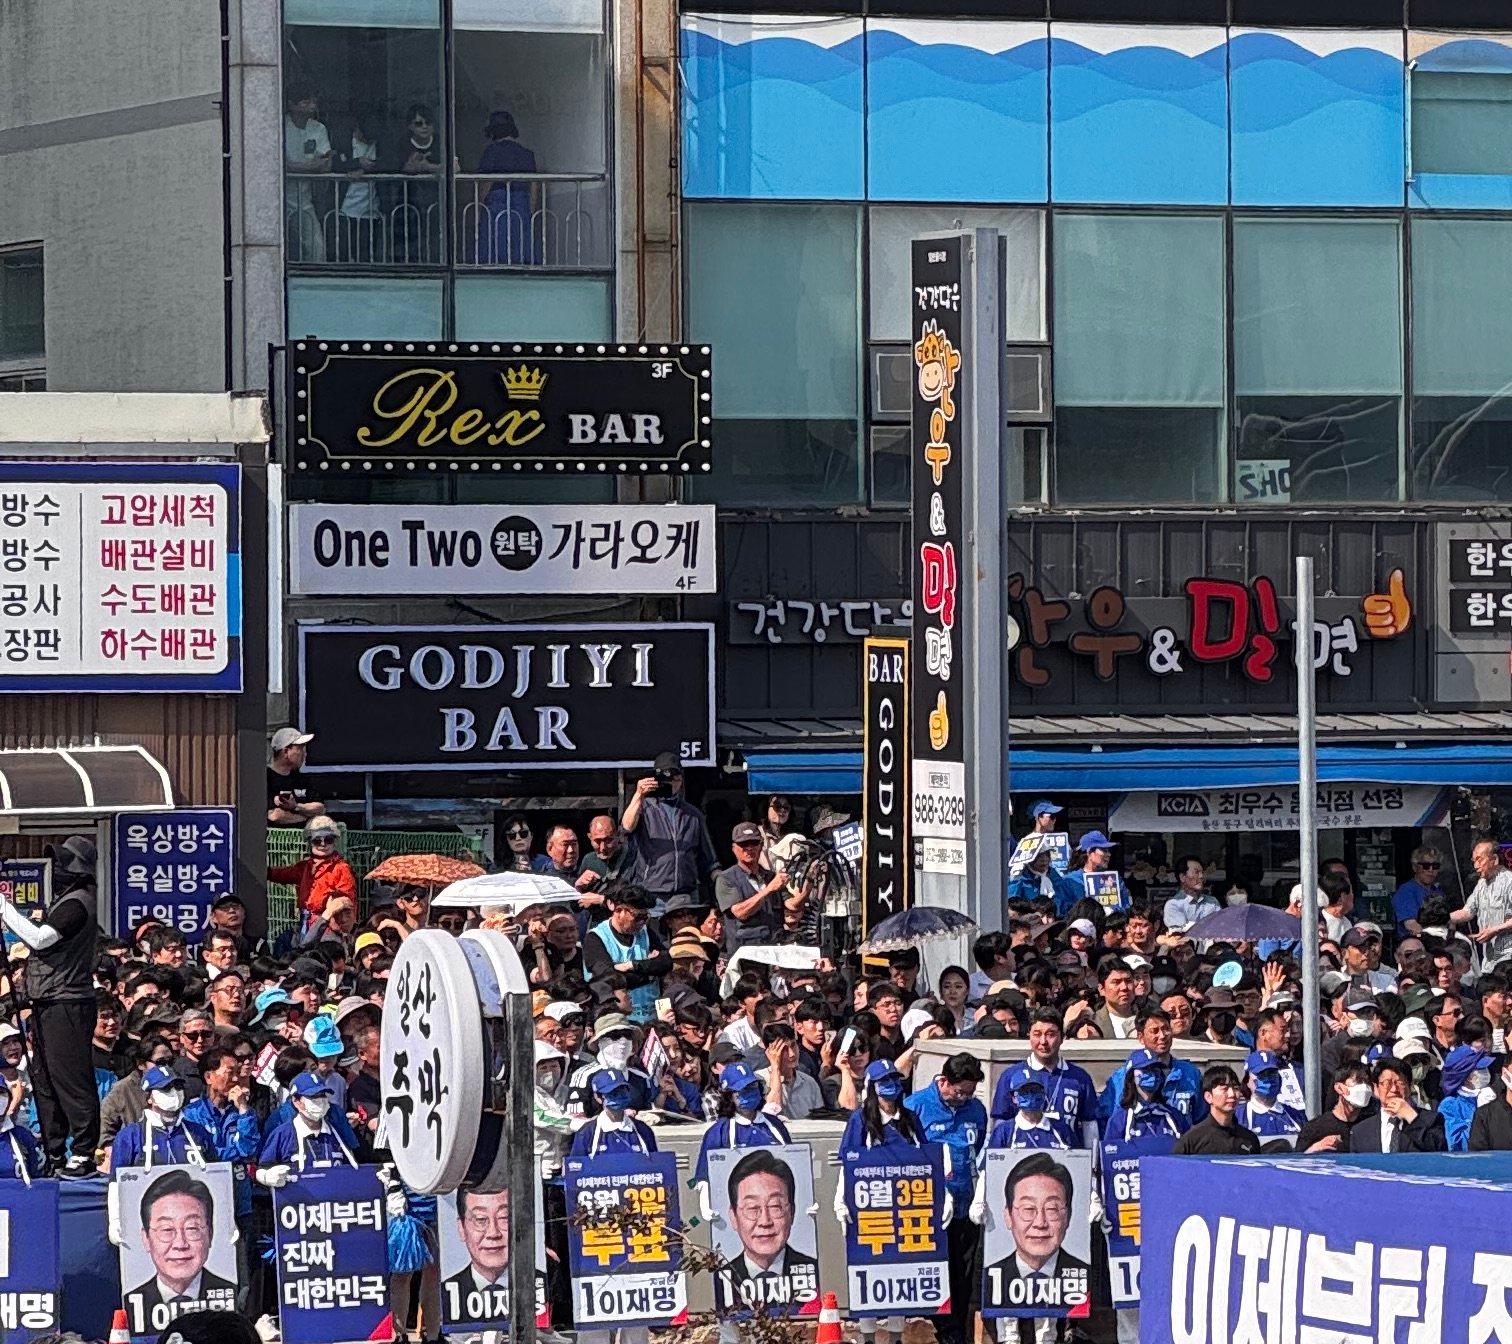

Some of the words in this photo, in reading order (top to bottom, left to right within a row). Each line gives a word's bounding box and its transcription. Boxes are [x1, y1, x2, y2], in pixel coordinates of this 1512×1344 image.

[651, 362, 673, 379] 3F
[357, 367, 546, 448] Rex
[569, 413, 665, 445] BAR
[2, 494, 61, 527] 방수
[100, 494, 215, 527] 고압세척
[2, 539, 61, 573] 방수
[100, 539, 215, 572] 배관설비
[313, 519, 390, 567] One
[401, 520, 482, 567] Two
[494, 530, 539, 556] 원탁
[548, 519, 700, 570] 가라오케
[675, 575, 698, 591] 4F
[1, 584, 62, 617] 공사
[100, 584, 217, 616] 수도배관
[100, 629, 217, 661] 하수배관
[1149, 628, 1184, 674] &
[358, 643, 655, 698] GODJIYI
[869, 653, 904, 683] BAR
[439, 706, 577, 752] BAR
[679, 741, 702, 758] 5F
[1218, 791, 1284, 815] 최우수
[126, 824, 224, 854] 옥상방수
[126, 864, 224, 894] 욕실방수
[397, 961, 436, 1040] 일산
[385, 1047, 448, 1161] 주막
[854, 1180, 893, 1208] 6월
[896, 1178, 934, 1206] 3일
[280, 1199, 382, 1235] 이제부터
[857, 1208, 936, 1255] 투표
[283, 1239, 335, 1273] 진짜
[582, 1217, 670, 1266] 투표
[284, 1276, 386, 1310] 대한민국
[741, 1274, 817, 1308] 이재명
[856, 1270, 868, 1304] 1
[873, 1276, 941, 1303] 이재명
[988, 1268, 1002, 1306] 1
[1009, 1278, 1088, 1306] 이재명
[1119, 1262, 1131, 1295] 1
[128, 1294, 146, 1333] 1
[445, 1282, 460, 1320] 1
[582, 1283, 596, 1317] 1
[599, 1286, 677, 1313] 이재명
